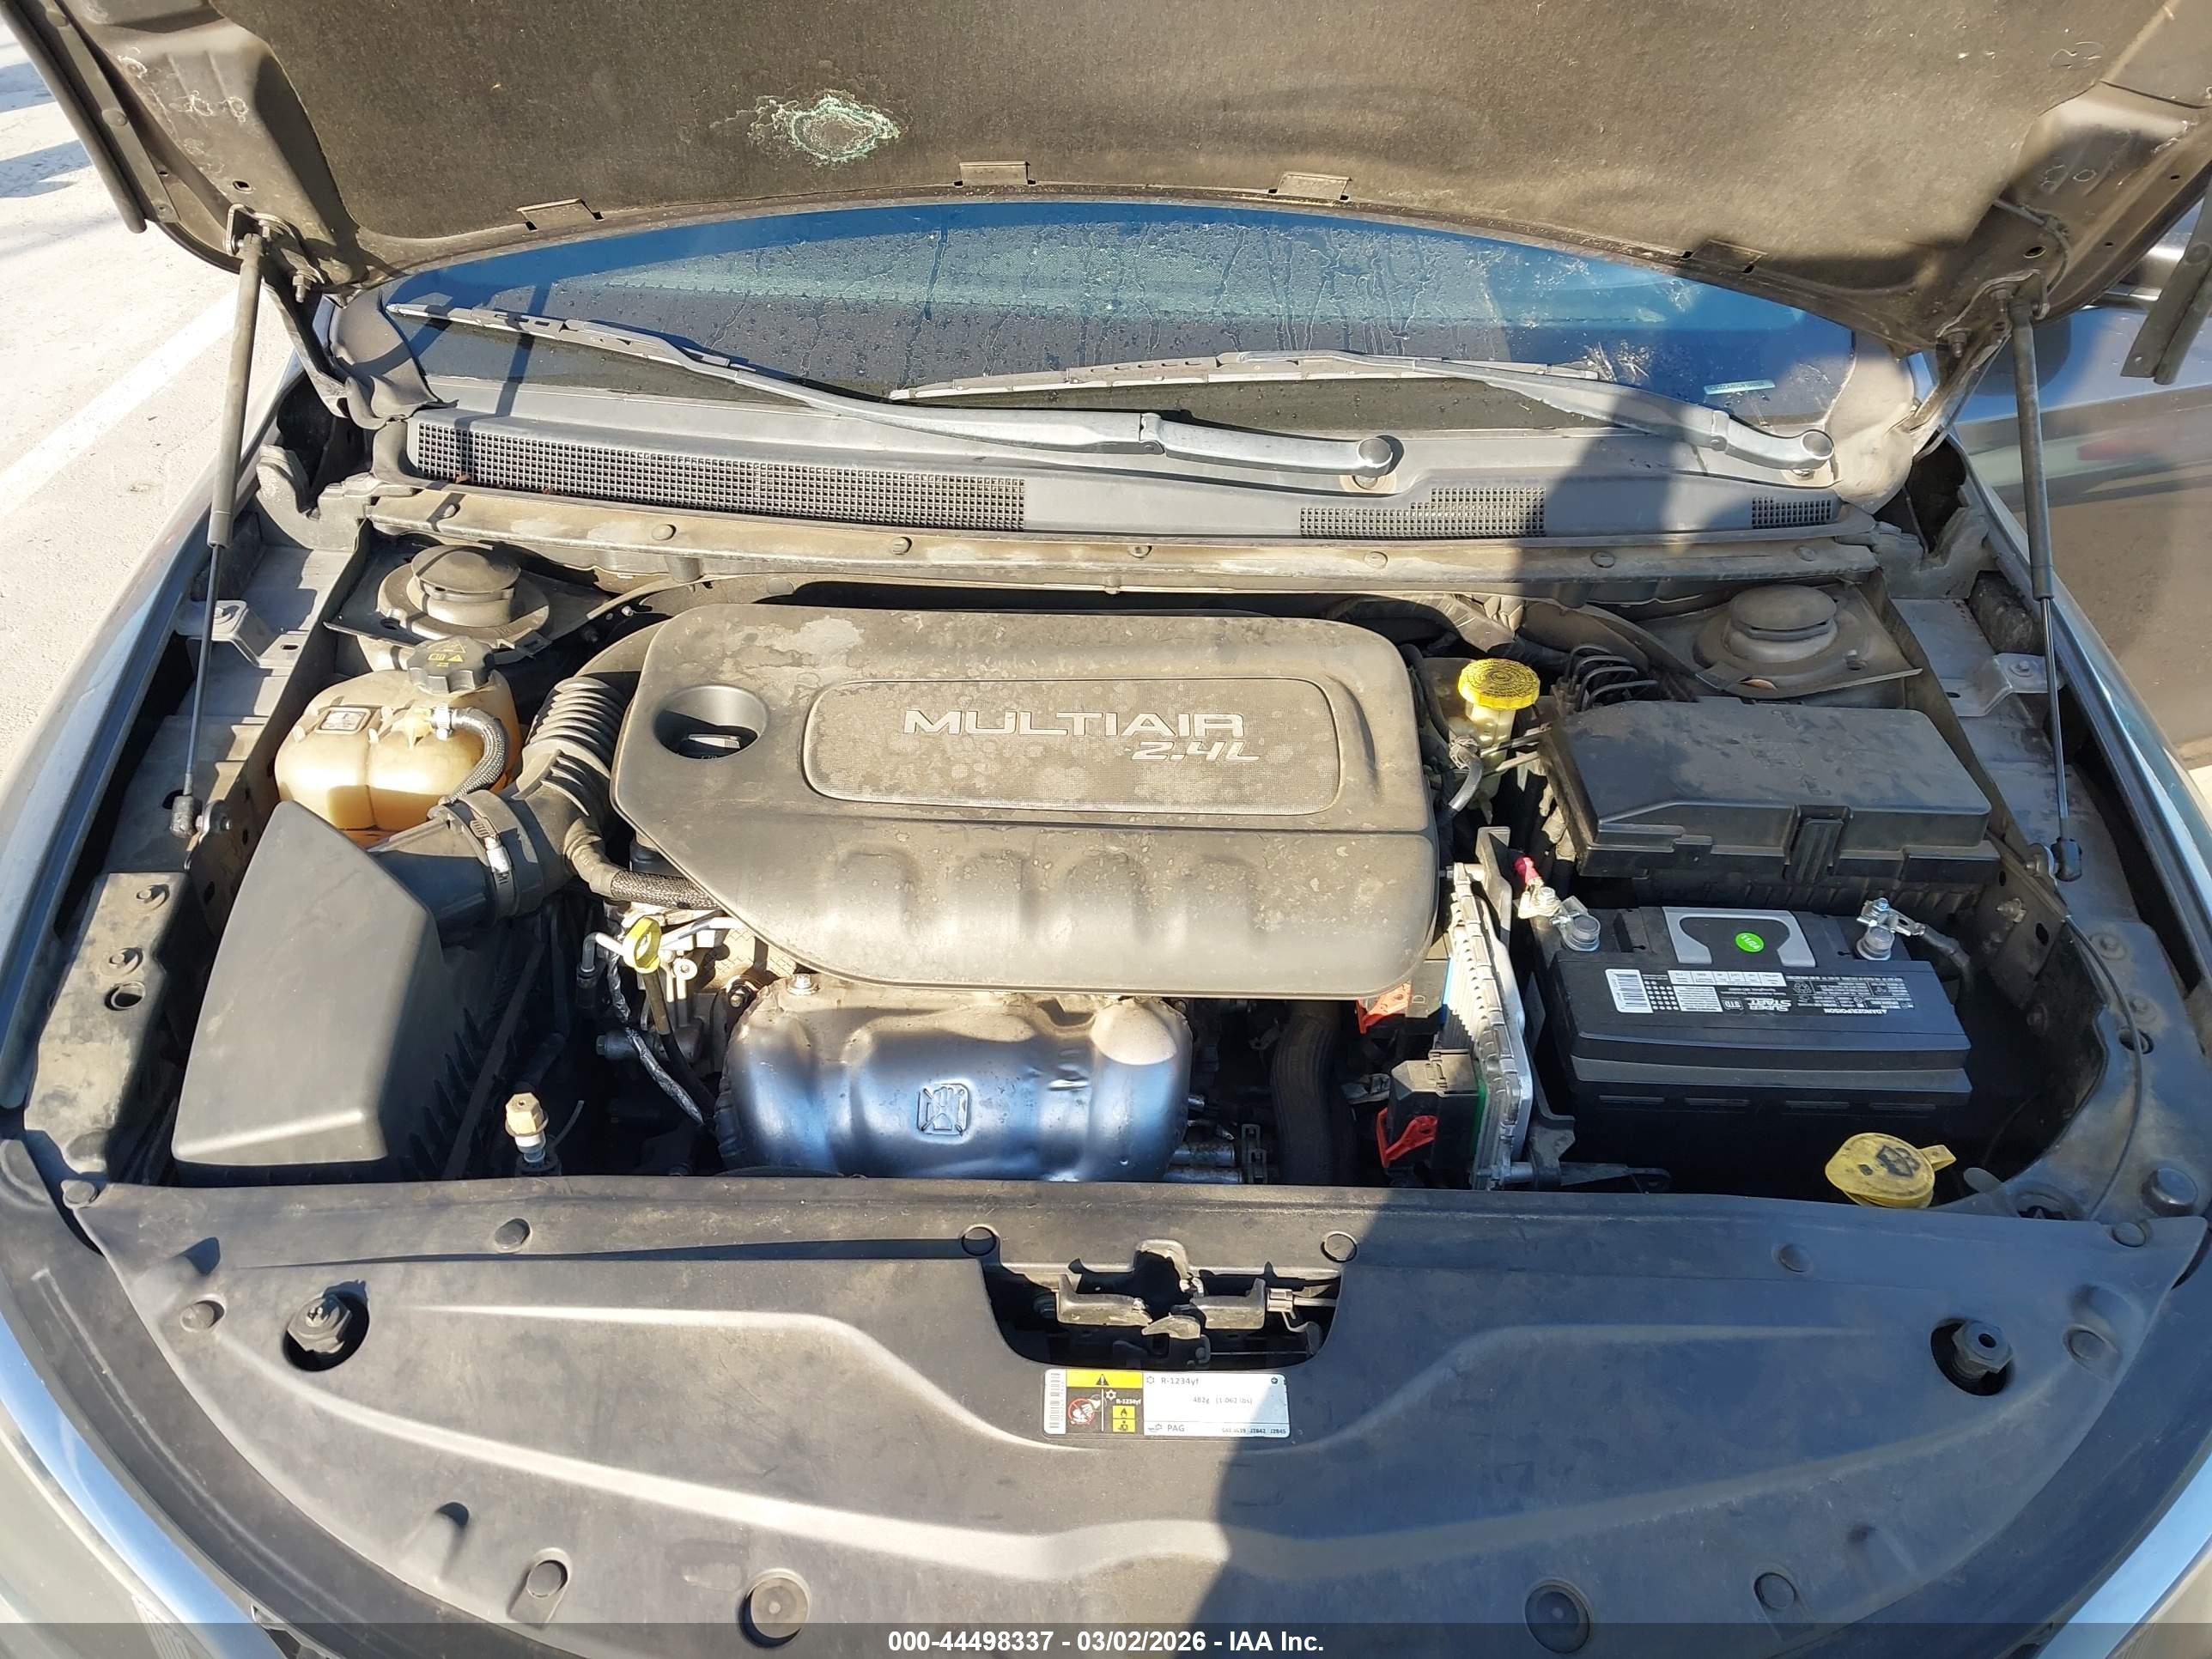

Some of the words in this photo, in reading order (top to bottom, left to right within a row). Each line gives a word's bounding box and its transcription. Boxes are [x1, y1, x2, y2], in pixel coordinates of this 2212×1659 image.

[903, 709, 1244, 737] MULTIAIR
[1130, 740, 1261, 763] 2.4L
[1747, 999, 1791, 1007] START
[1161, 1377, 1199, 1386] R-1234yf
